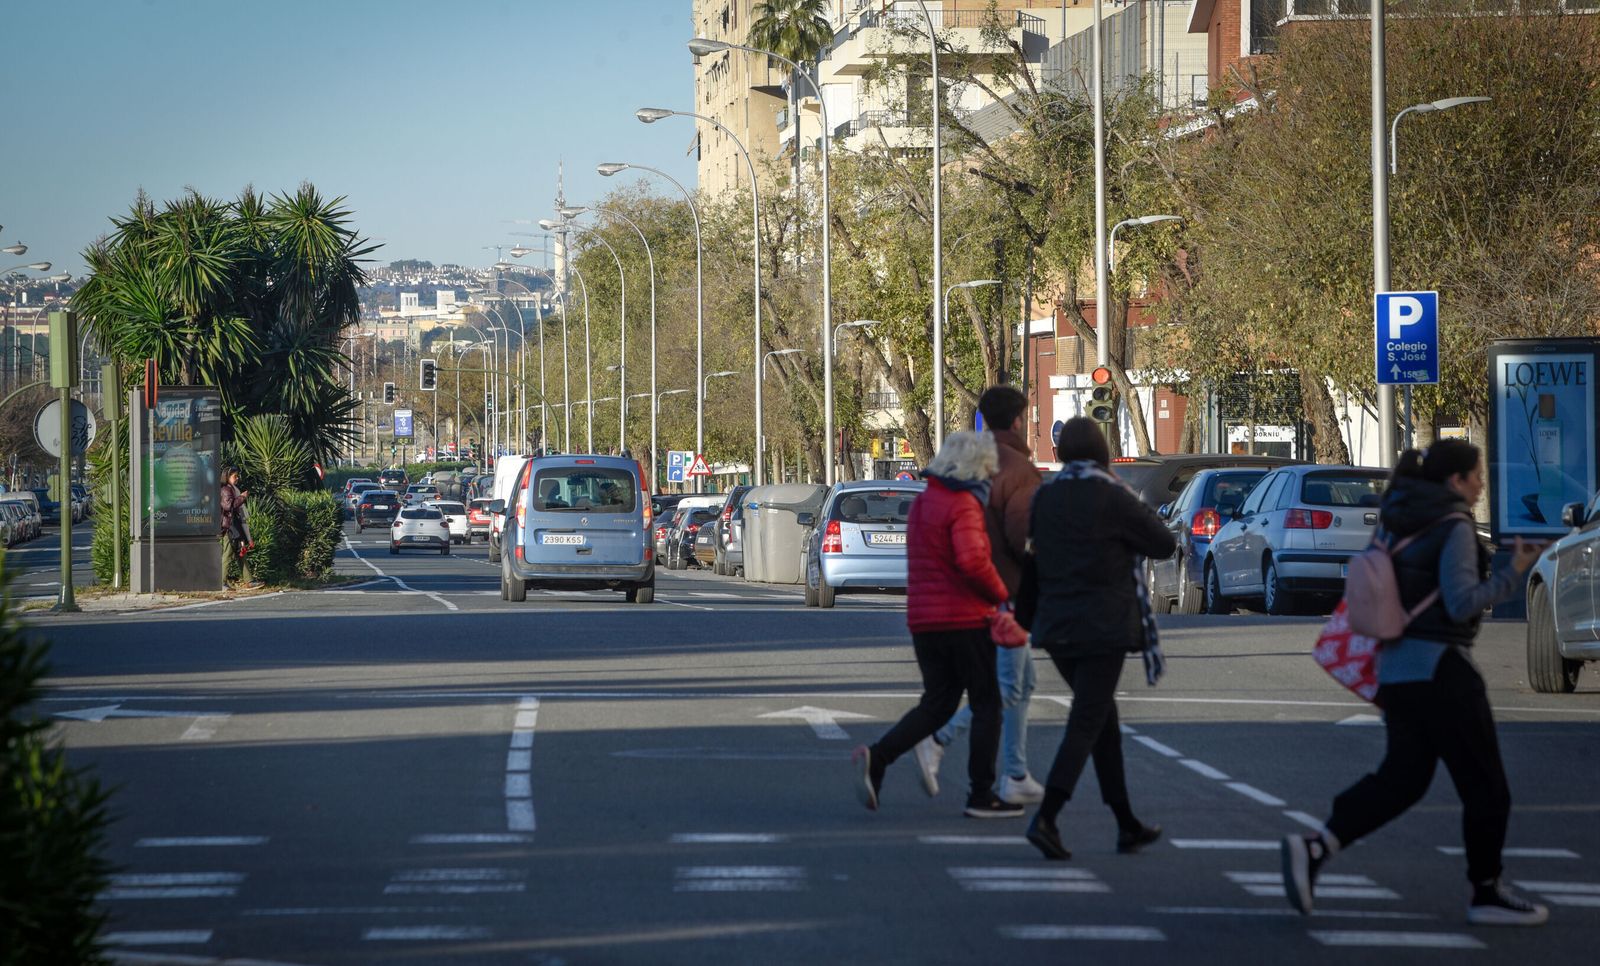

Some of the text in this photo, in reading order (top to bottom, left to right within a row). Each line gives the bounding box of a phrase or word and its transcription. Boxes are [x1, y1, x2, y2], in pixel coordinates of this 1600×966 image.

[1389, 296, 1423, 339] P
[1386, 341, 1428, 353] Colegio
[1387, 351, 1427, 361] S. José
[1504, 361, 1587, 387] LOEWE
[1243, 429, 1280, 438] CDORNIU
[672, 454, 681, 466] P
[544, 535, 564, 544] 2390
[874, 534, 908, 543] 5244 FF
